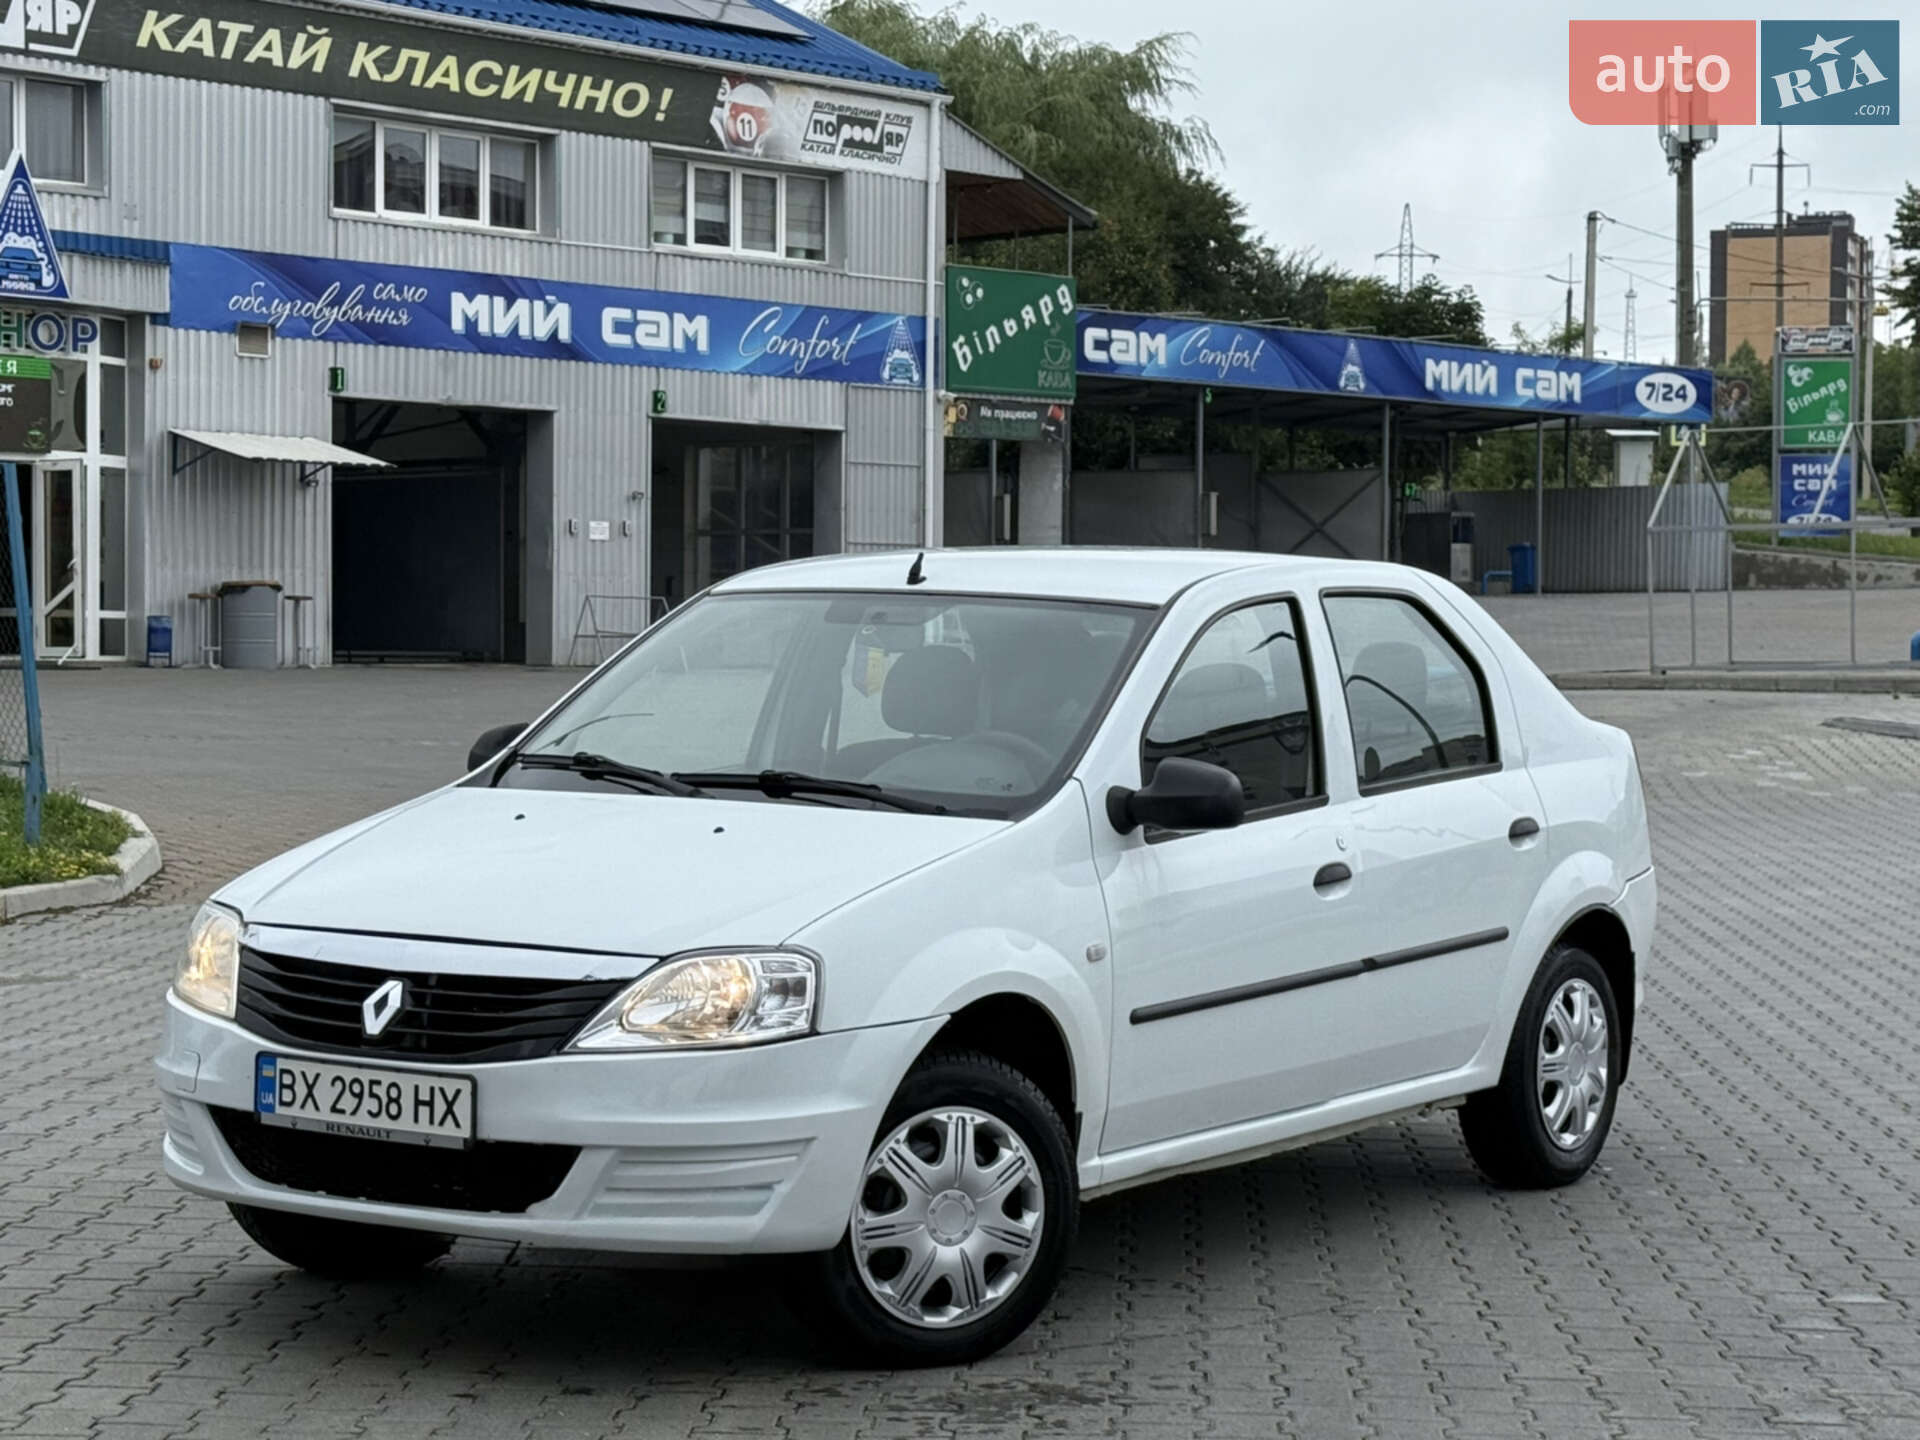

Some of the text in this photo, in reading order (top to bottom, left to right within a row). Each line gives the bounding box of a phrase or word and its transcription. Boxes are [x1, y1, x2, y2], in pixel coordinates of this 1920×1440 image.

[135, 10, 334, 73] КАТАЙ
[813, 101, 914, 124] БІЛЬЯРДНИЙ КЛУБ
[740, 117, 752, 137] 11
[800, 143, 836, 155] КАТАЙ
[228, 281, 412, 336] обслуговування
[739, 306, 863, 374] Comfort
[1180, 327, 1265, 379] Comfort
[657, 391, 667, 411] 2
[1644, 382, 1688, 403] 7/24
[261, 1092, 274, 1105] UA
[278, 1068, 463, 1129] BX 2958 HX
[325, 1123, 393, 1139] RENAULT
